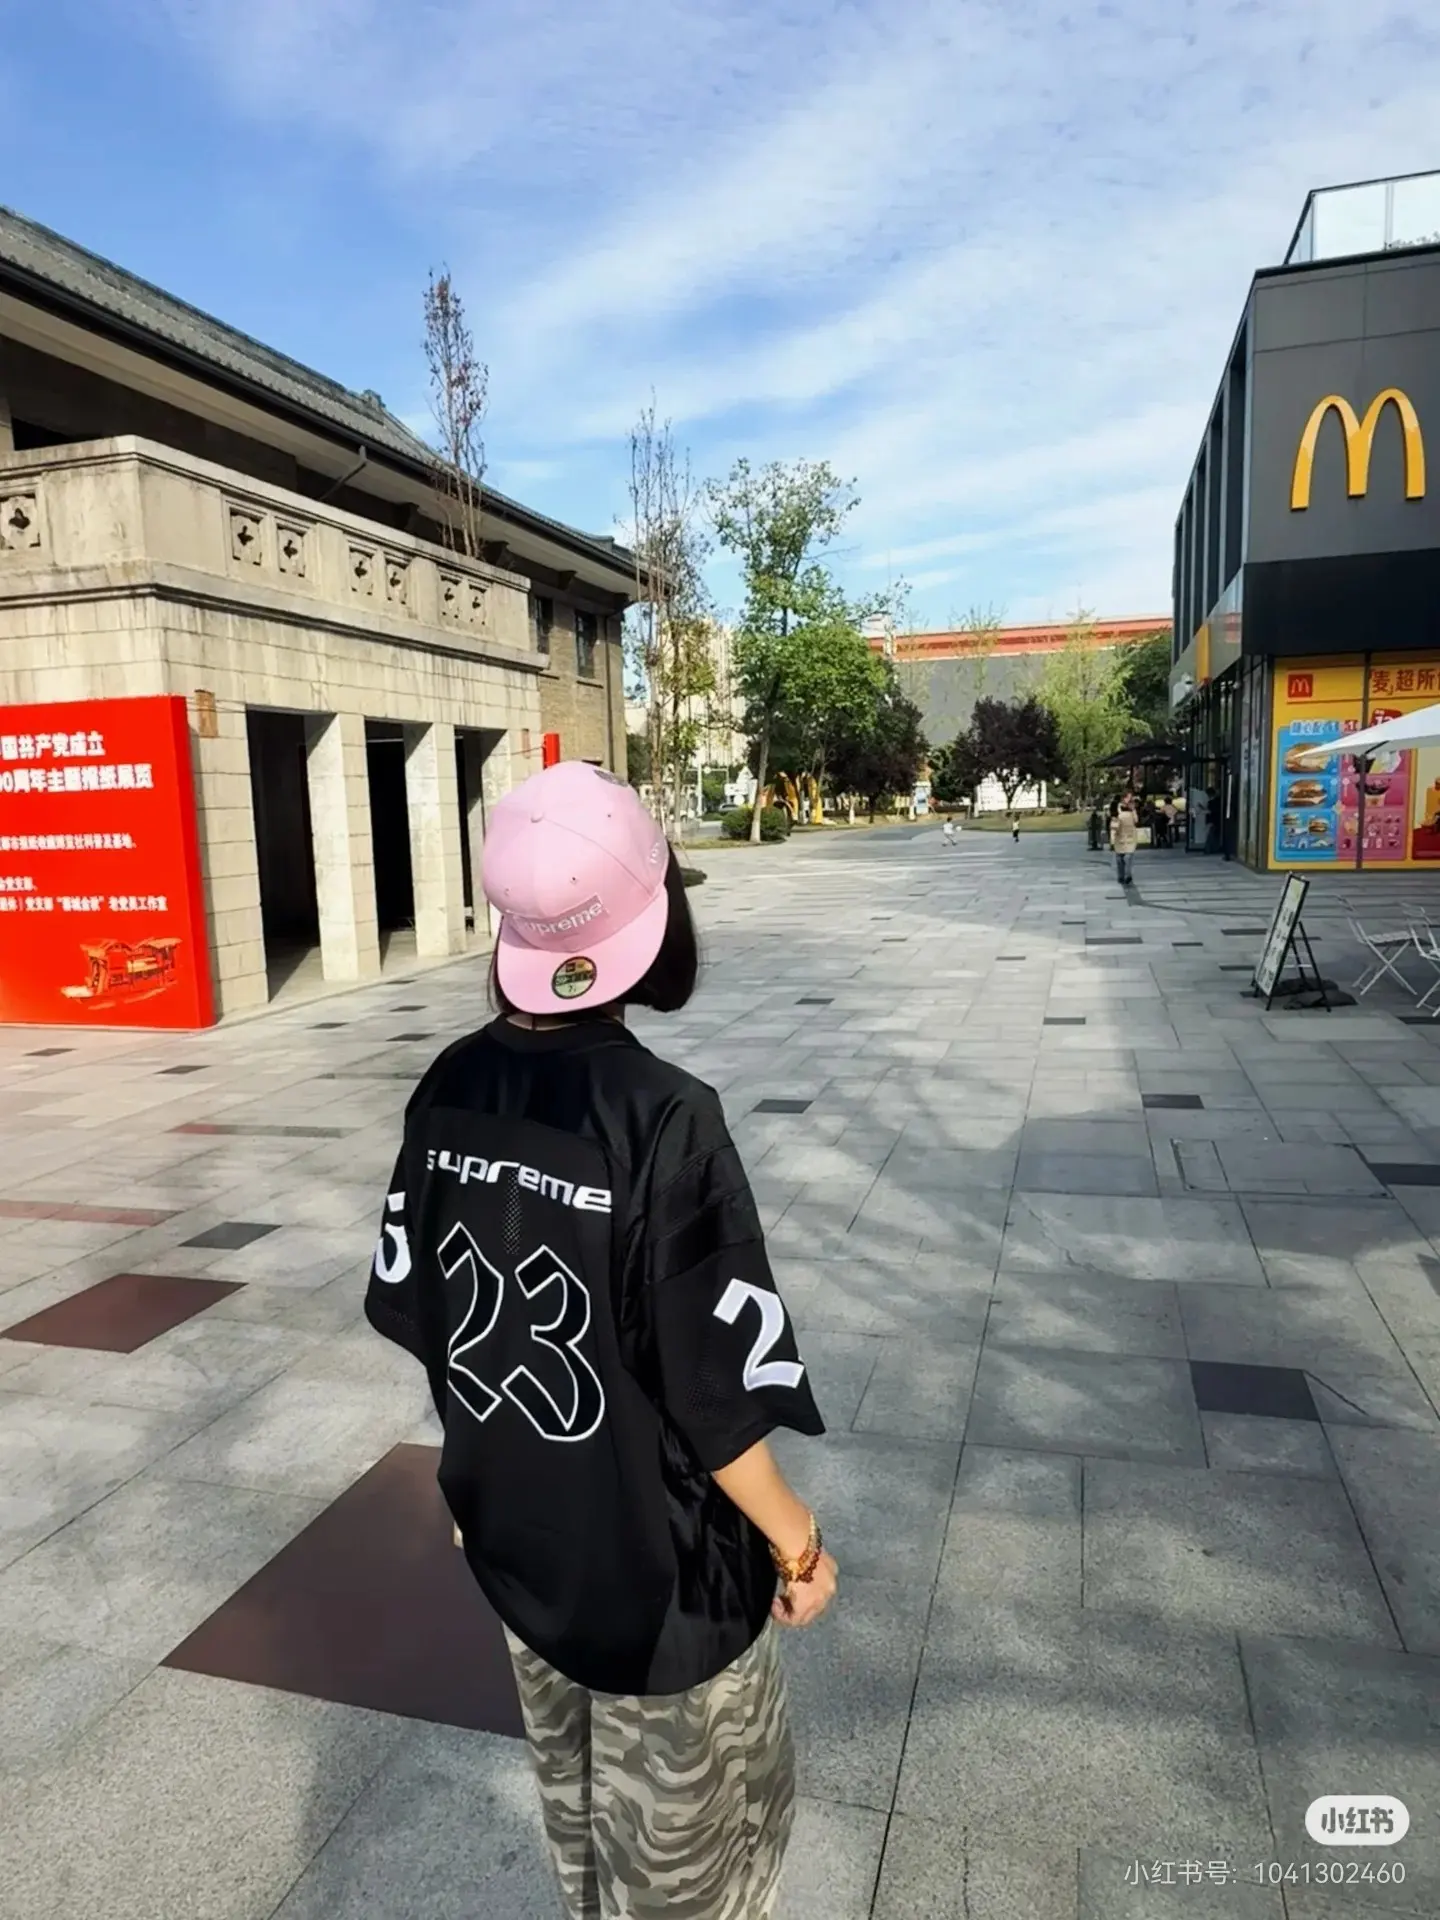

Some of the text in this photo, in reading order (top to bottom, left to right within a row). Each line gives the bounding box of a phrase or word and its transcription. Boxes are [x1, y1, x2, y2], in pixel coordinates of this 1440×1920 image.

[0, 730, 106, 760] 国共产党成立
[0, 763, 154, 793] 0周年主题报纸展览
[437, 1221, 605, 1442] 23
[712, 1278, 804, 1391] 2
